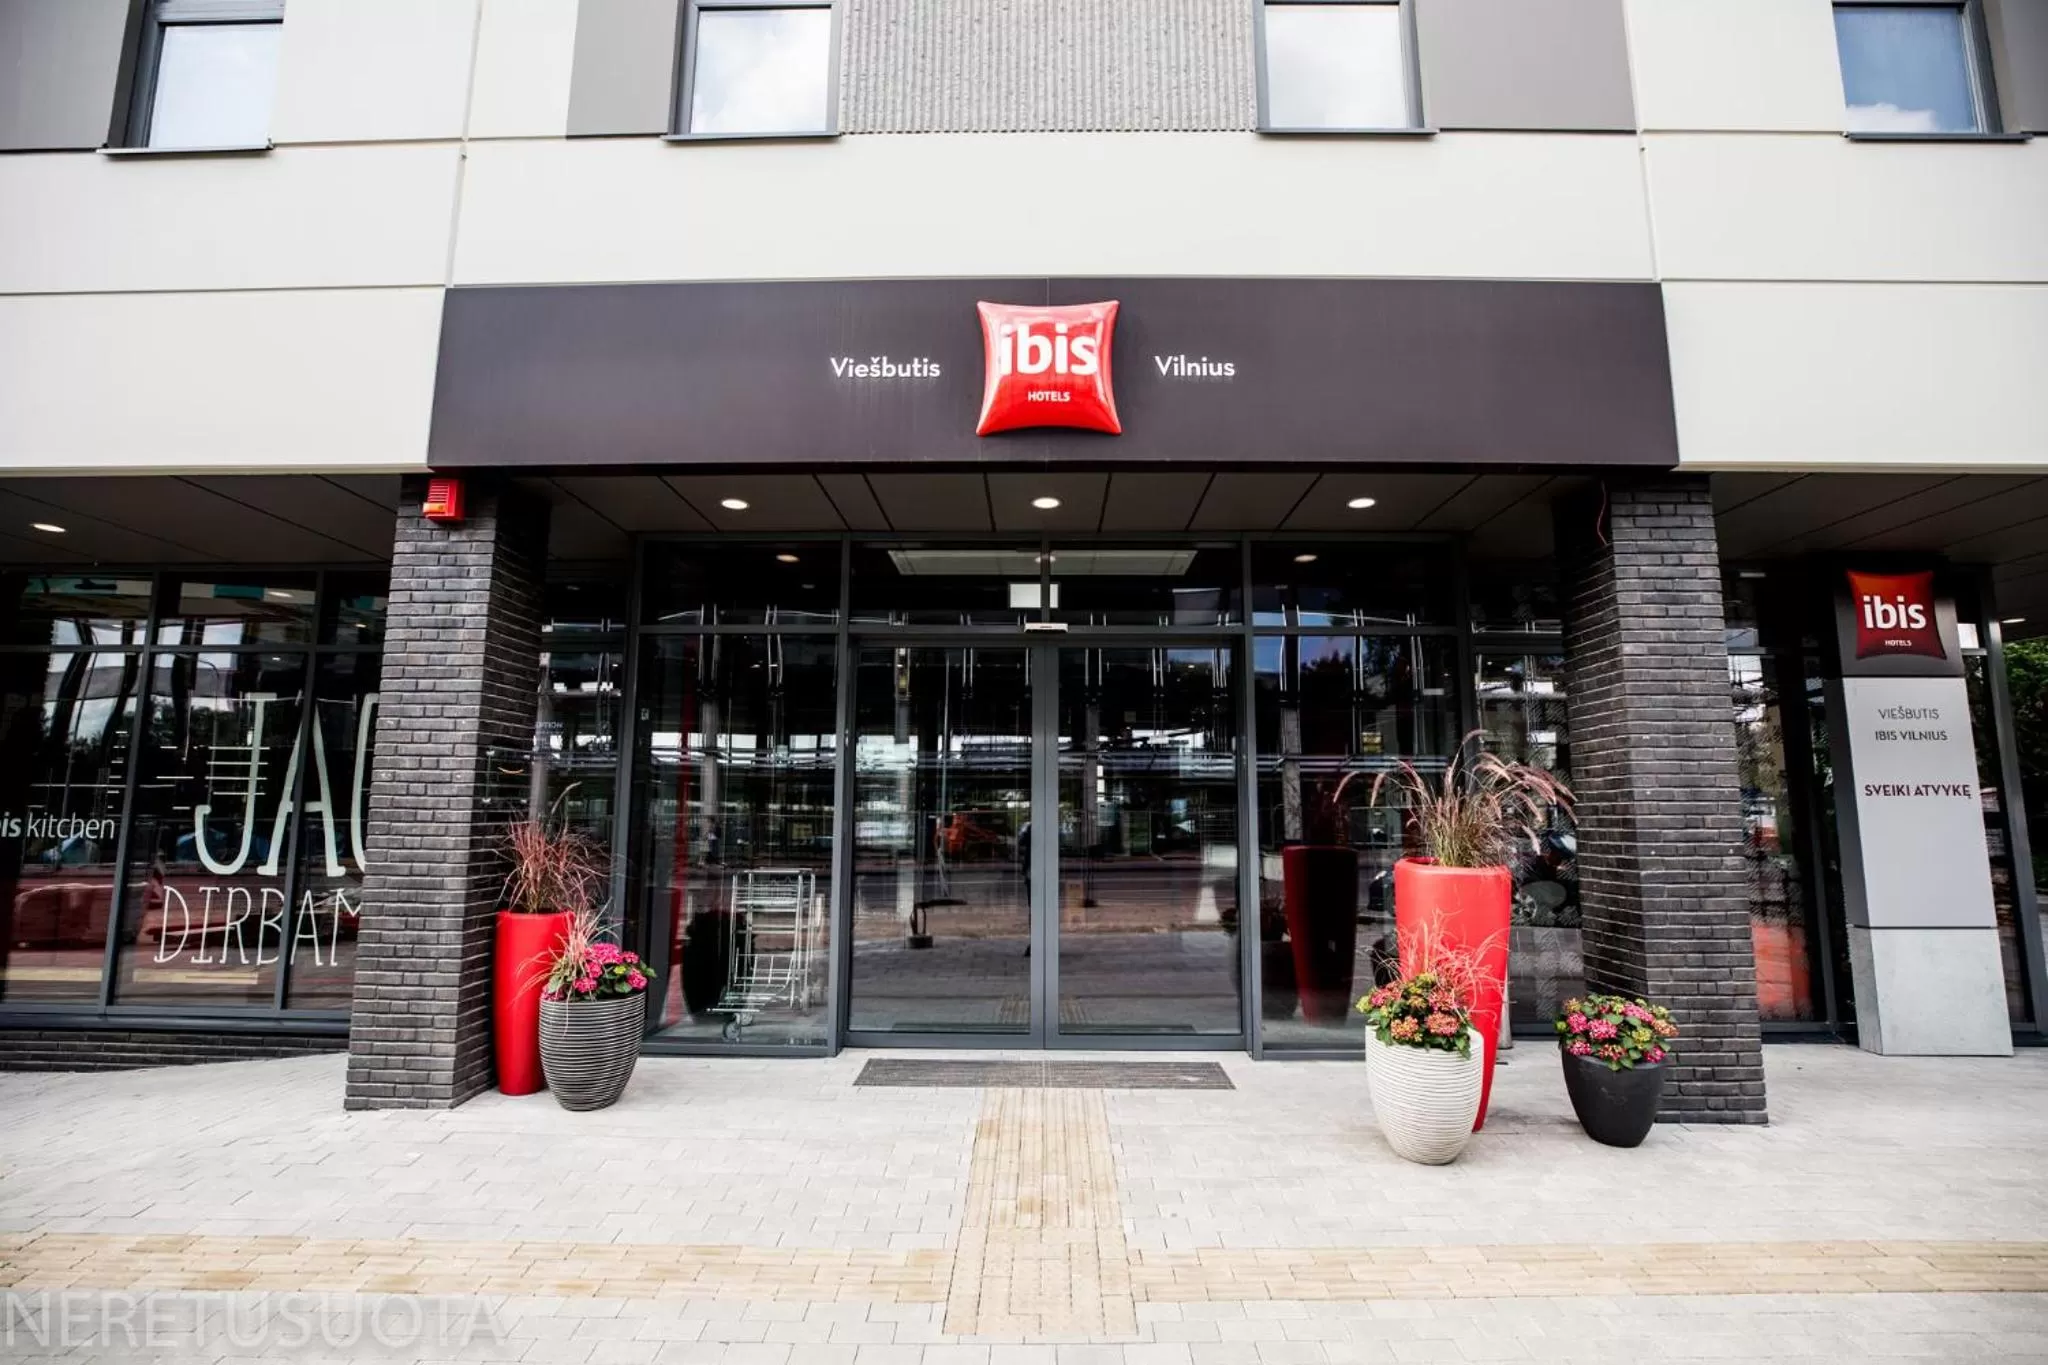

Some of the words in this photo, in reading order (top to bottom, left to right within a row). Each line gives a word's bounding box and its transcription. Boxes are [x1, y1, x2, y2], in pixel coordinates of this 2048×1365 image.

[1000, 323, 1099, 376] ibis
[830, 356, 941, 378] Viešbutis
[1154, 355, 1236, 378] Vilnius
[1027, 390, 1071, 402] HOTELS
[1863, 595, 1926, 629] ibis
[1885, 639, 1912, 647] HOTELS
[1878, 705, 1939, 720] VIEŠBUTIS
[1875, 730, 1897, 741] IBIS
[1899, 729, 1948, 741] VILNIUS
[1864, 784, 1911, 797] SVEIKI
[1914, 784, 1971, 799] ATVYKĘ
[0, 811, 22, 838] is
[26, 811, 116, 840] kitchen
